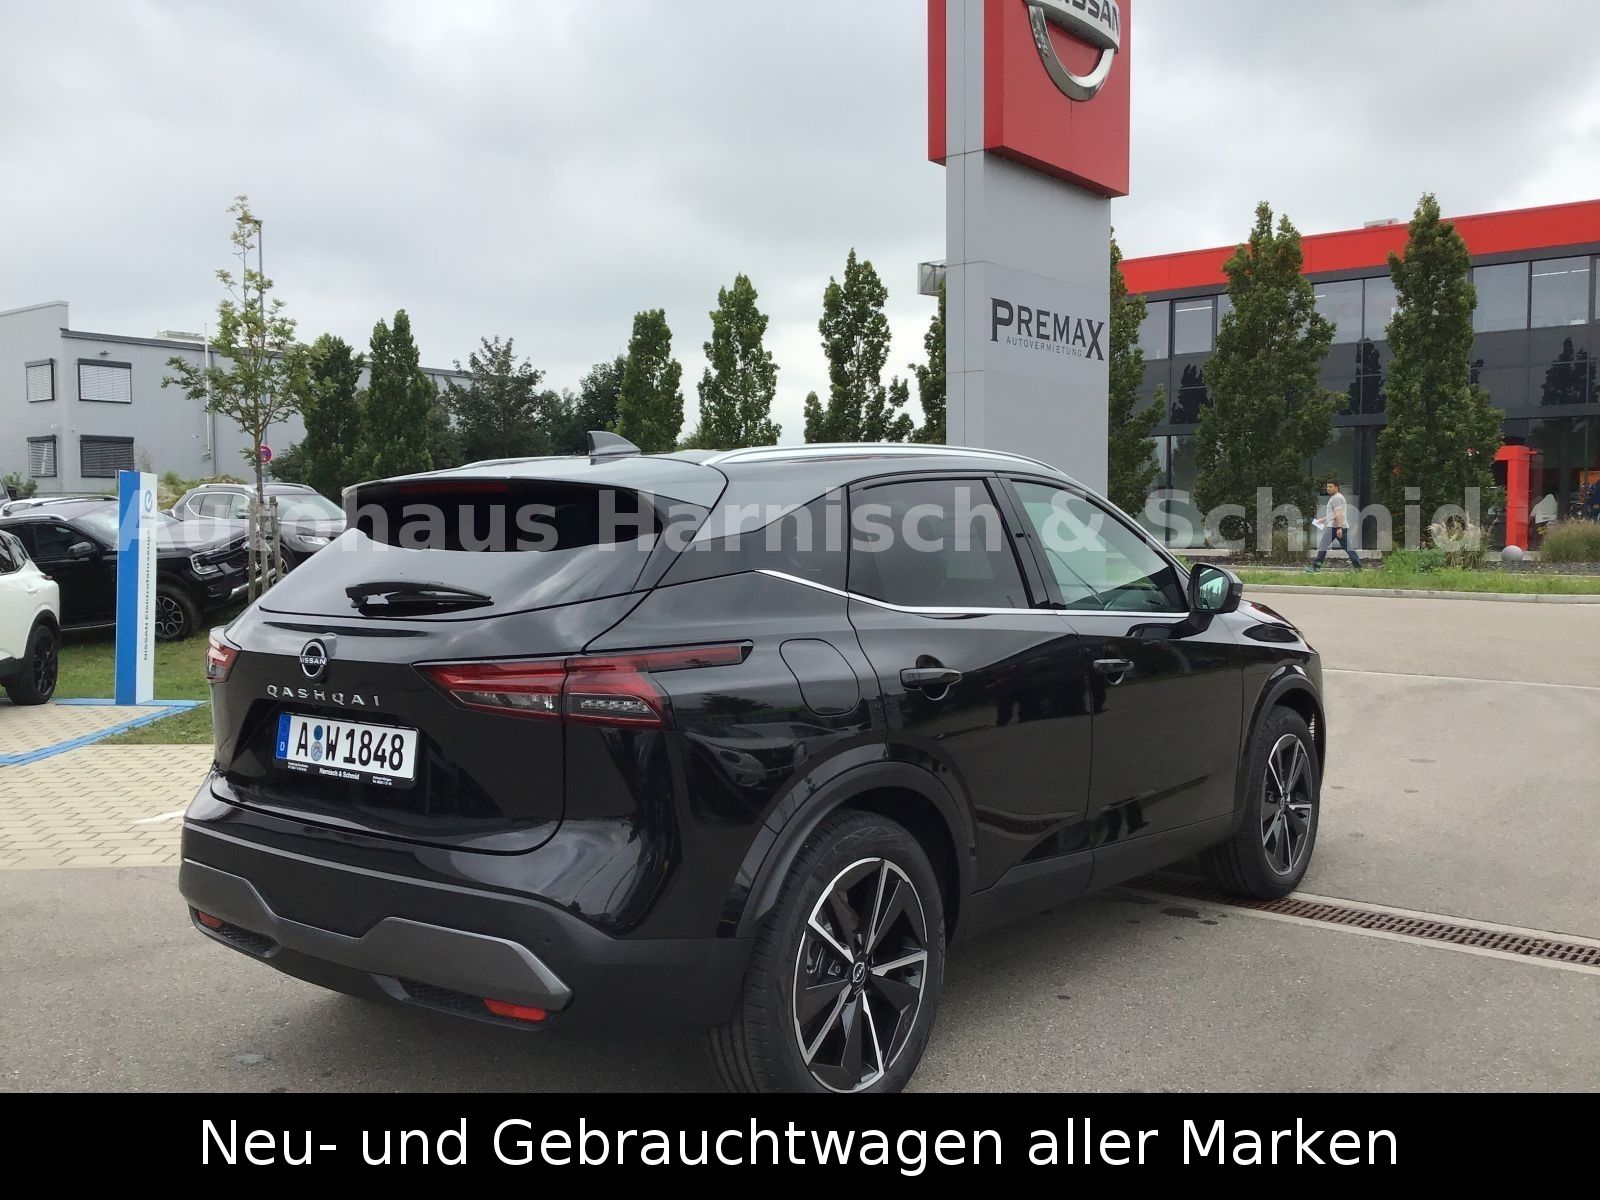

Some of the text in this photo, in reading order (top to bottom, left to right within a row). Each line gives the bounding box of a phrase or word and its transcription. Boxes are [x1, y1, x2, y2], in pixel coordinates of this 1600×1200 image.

[991, 297, 1105, 361] PREMAX
[1006, 336, 1083, 358] AUTOVERMIETUNG
[300, 655, 327, 666] NISSAN
[266, 684, 380, 707] QASHQAI
[343, 771, 360, 781] Schmid
